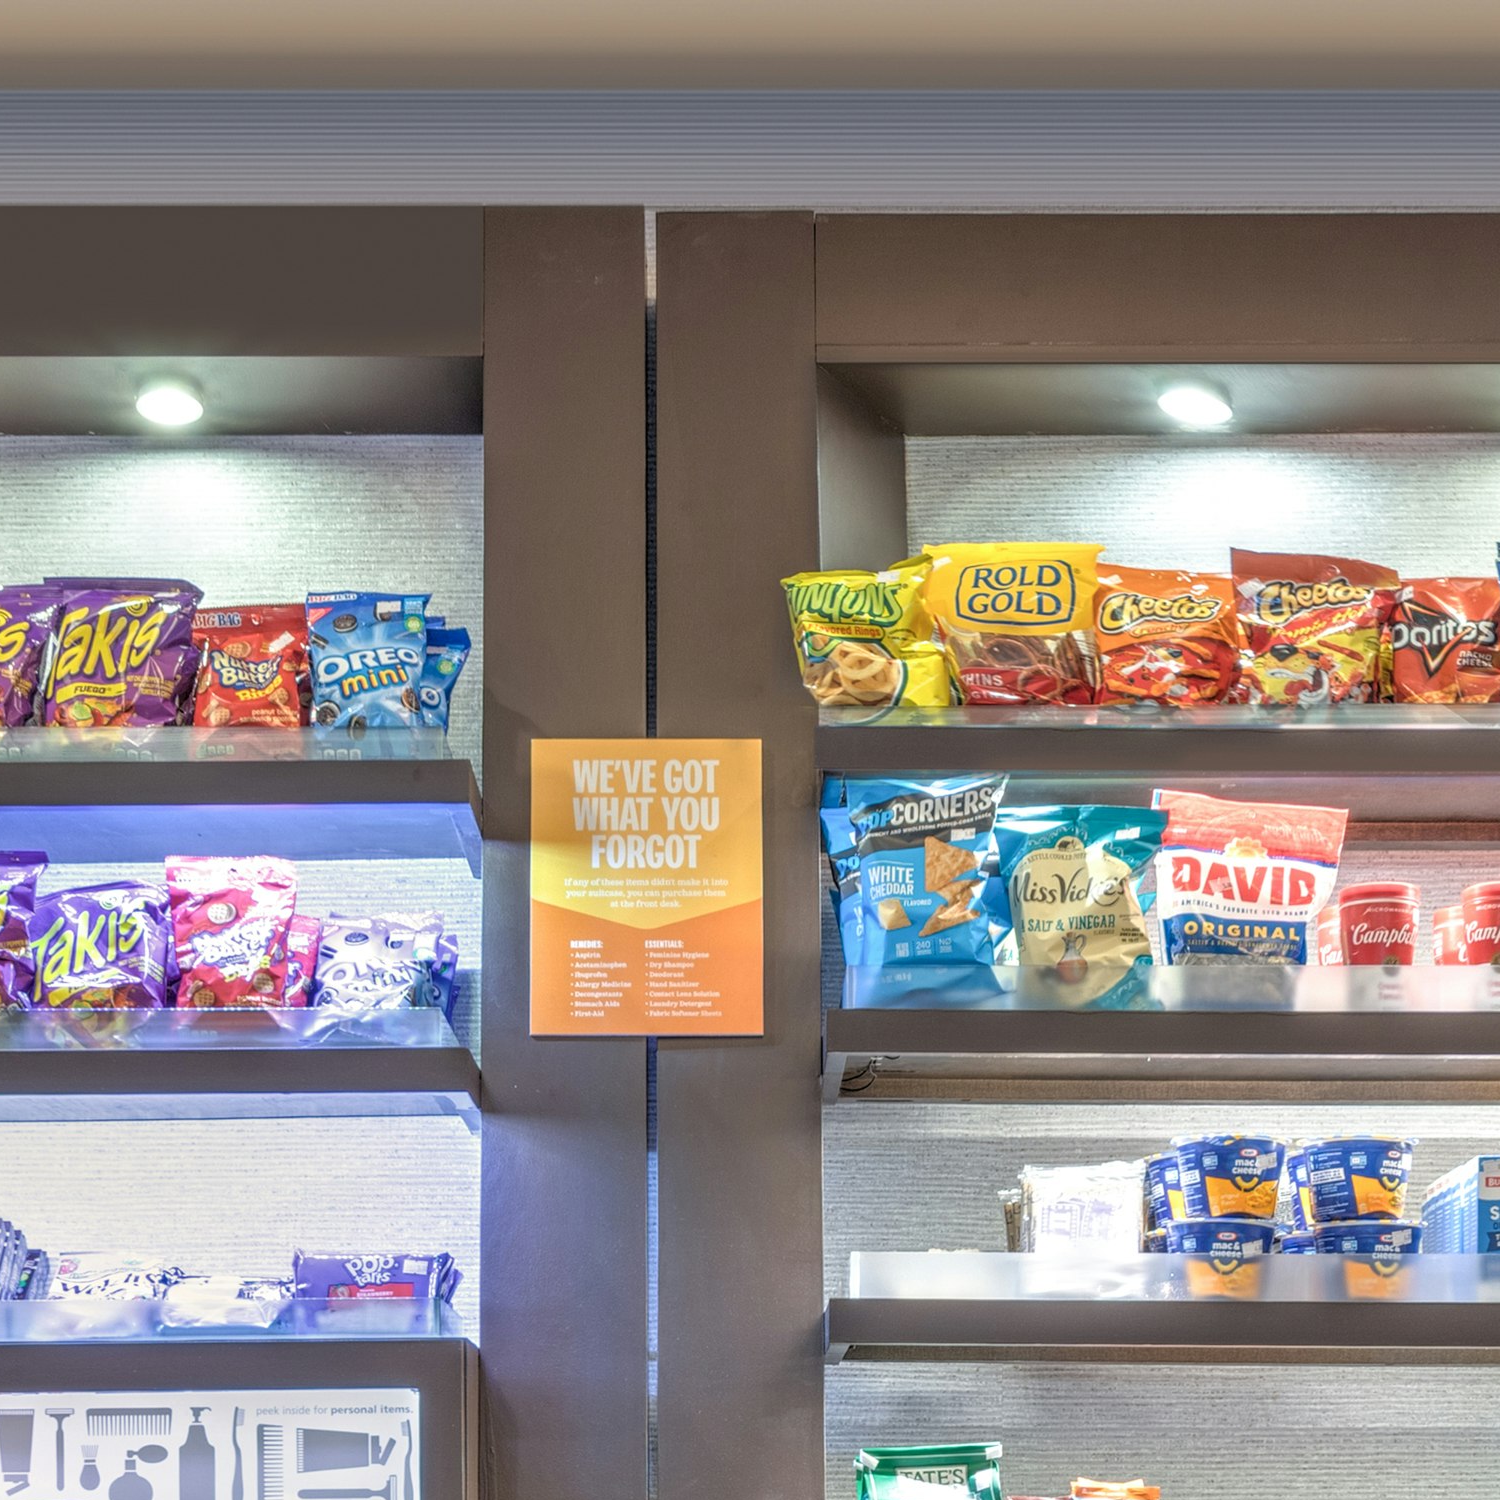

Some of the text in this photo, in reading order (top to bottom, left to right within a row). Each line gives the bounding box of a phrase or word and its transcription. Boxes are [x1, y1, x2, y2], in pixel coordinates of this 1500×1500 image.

[972, 565, 1062, 589] ROLD
[967, 592, 1062, 616] GOLD
[1257, 578, 1373, 626] Cheetos
[194, 613, 241, 627] BIG BAG
[1099, 592, 1222, 635] Cheetos
[1393, 620, 1498, 650] Doritos
[46, 600, 168, 700] Takis
[317, 647, 419, 683] OREO
[74, 685, 107, 695] FUEGO
[341, 665, 409, 699] mini
[572, 760, 719, 793] WE'VE GOT
[572, 797, 719, 831] WHAT YOU
[591, 835, 701, 868] FORGOT
[573, 880, 586, 888] any
[590, 878, 599, 886] of
[600, 878, 623, 886] these
[651, 878, 675, 886] didn't
[868, 865, 914, 887] WHITE
[1172, 857, 1317, 906] DAVID
[566, 890, 586, 899] your
[588, 889, 625, 898] suitcase,
[627, 890, 642, 899] you
[662, 889, 701, 899] purchase
[704, 889, 725, 897] them
[870, 884, 914, 900] CHEDDAR
[636, 900, 657, 908] front
[904, 899, 932, 907] FLAVORED
[1028, 914, 1116, 932] SALT & VINEGAR
[1184, 921, 1300, 941] ORIGINAL
[645, 940, 684, 948] ESSENTIALS:
[575, 952, 601, 960] Aspirin
[682, 952, 710, 960] Hygiene
[649, 962, 662, 970] Dry
[575, 971, 608, 979] Ibuprofen
[575, 981, 600, 989] Allergy
[575, 991, 623, 999] Decongestants
[355, 1270, 391, 1287] tarts
[256, 1405, 414, 1416] peek inside for personal items.
[900, 1468, 964, 1486] TATE'S
